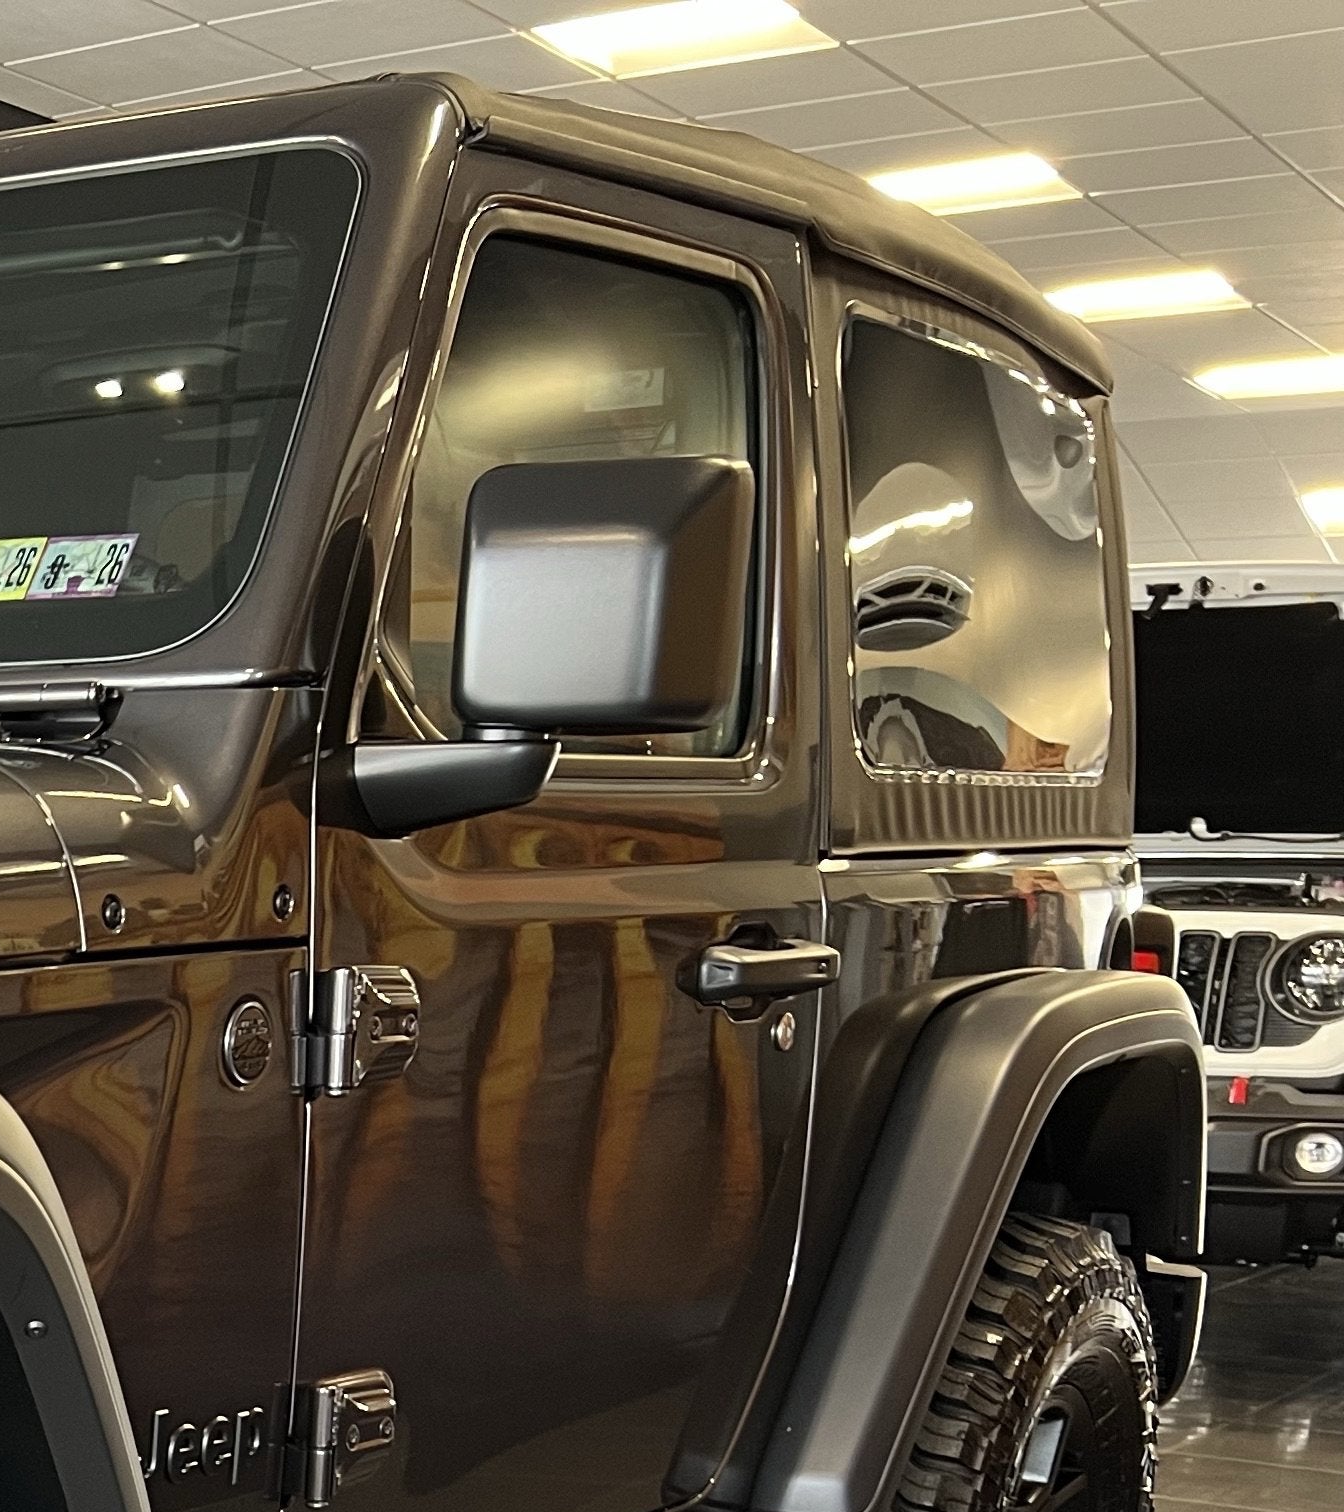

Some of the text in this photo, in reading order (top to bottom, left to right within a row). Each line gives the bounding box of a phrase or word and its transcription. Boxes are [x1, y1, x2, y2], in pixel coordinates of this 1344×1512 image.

[5, 547, 37, 588] 26
[95, 543, 130, 586] 26
[138, 1407, 265, 1485] Jeep
